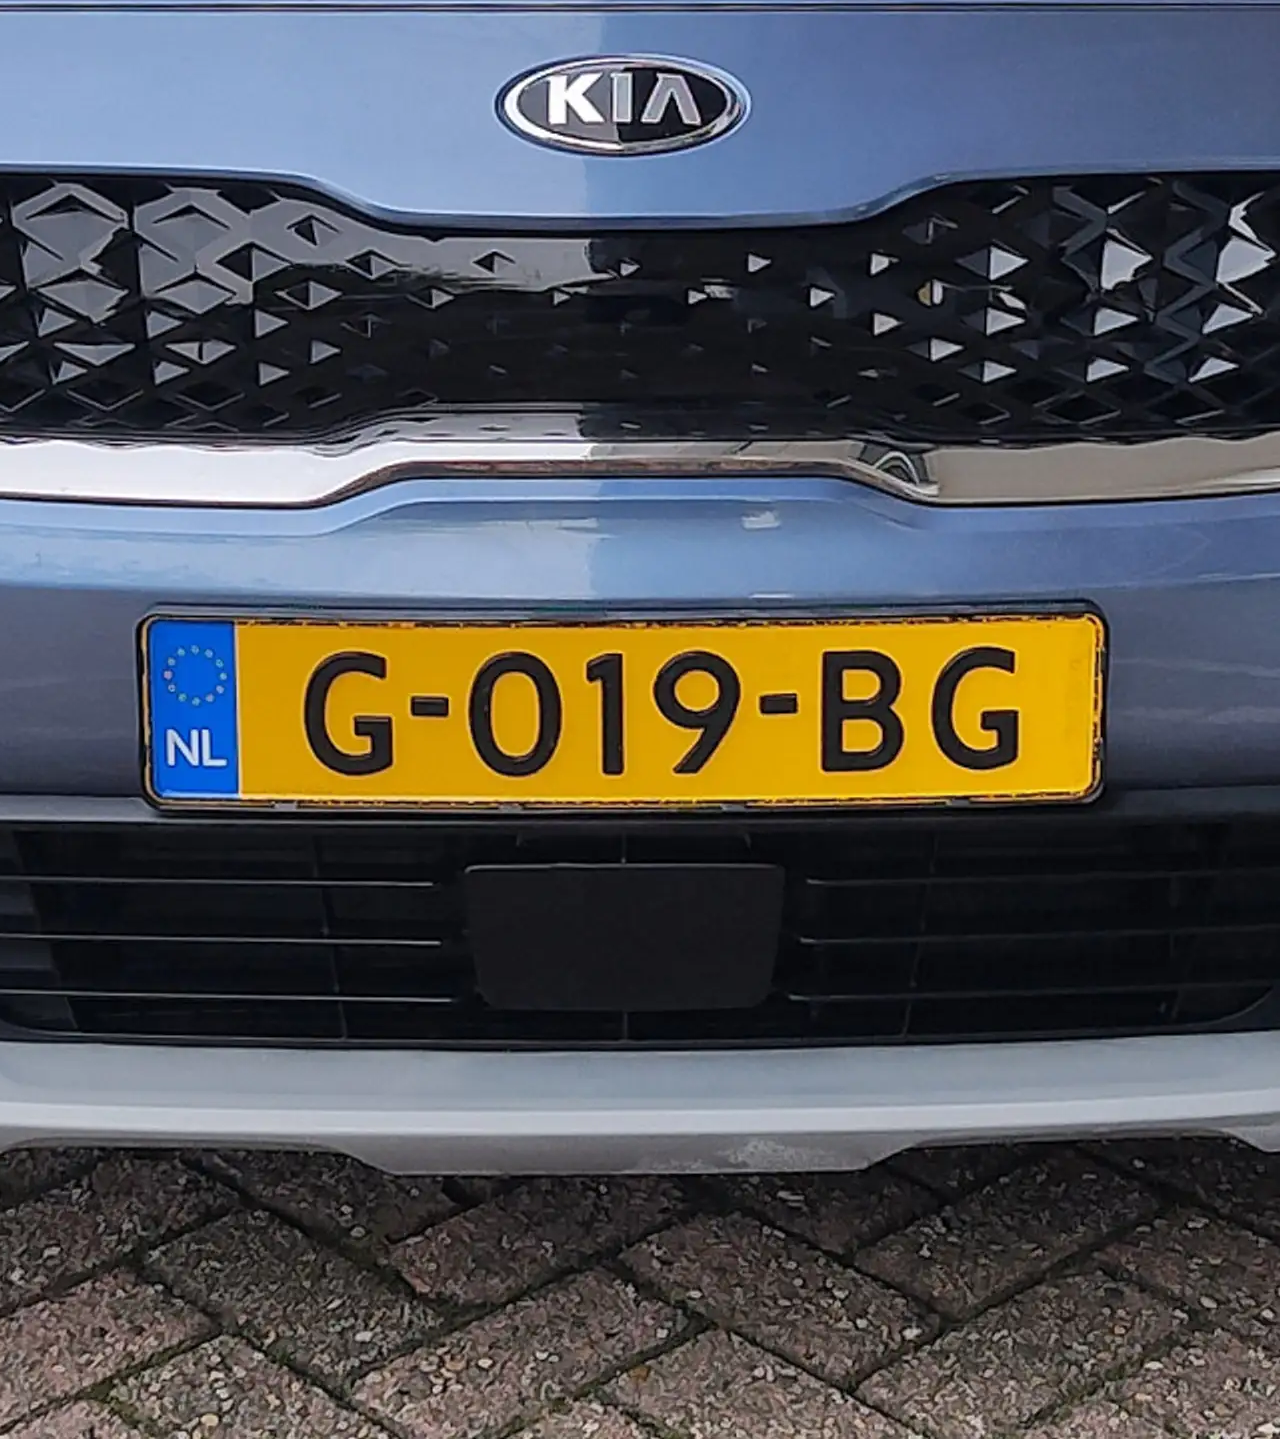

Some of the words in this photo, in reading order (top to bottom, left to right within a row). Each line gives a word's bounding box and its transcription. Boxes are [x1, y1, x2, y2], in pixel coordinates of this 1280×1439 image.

[546, 72, 702, 125] KIA
[303, 646, 1020, 777] G-019-BG
[166, 728, 228, 767] NL
